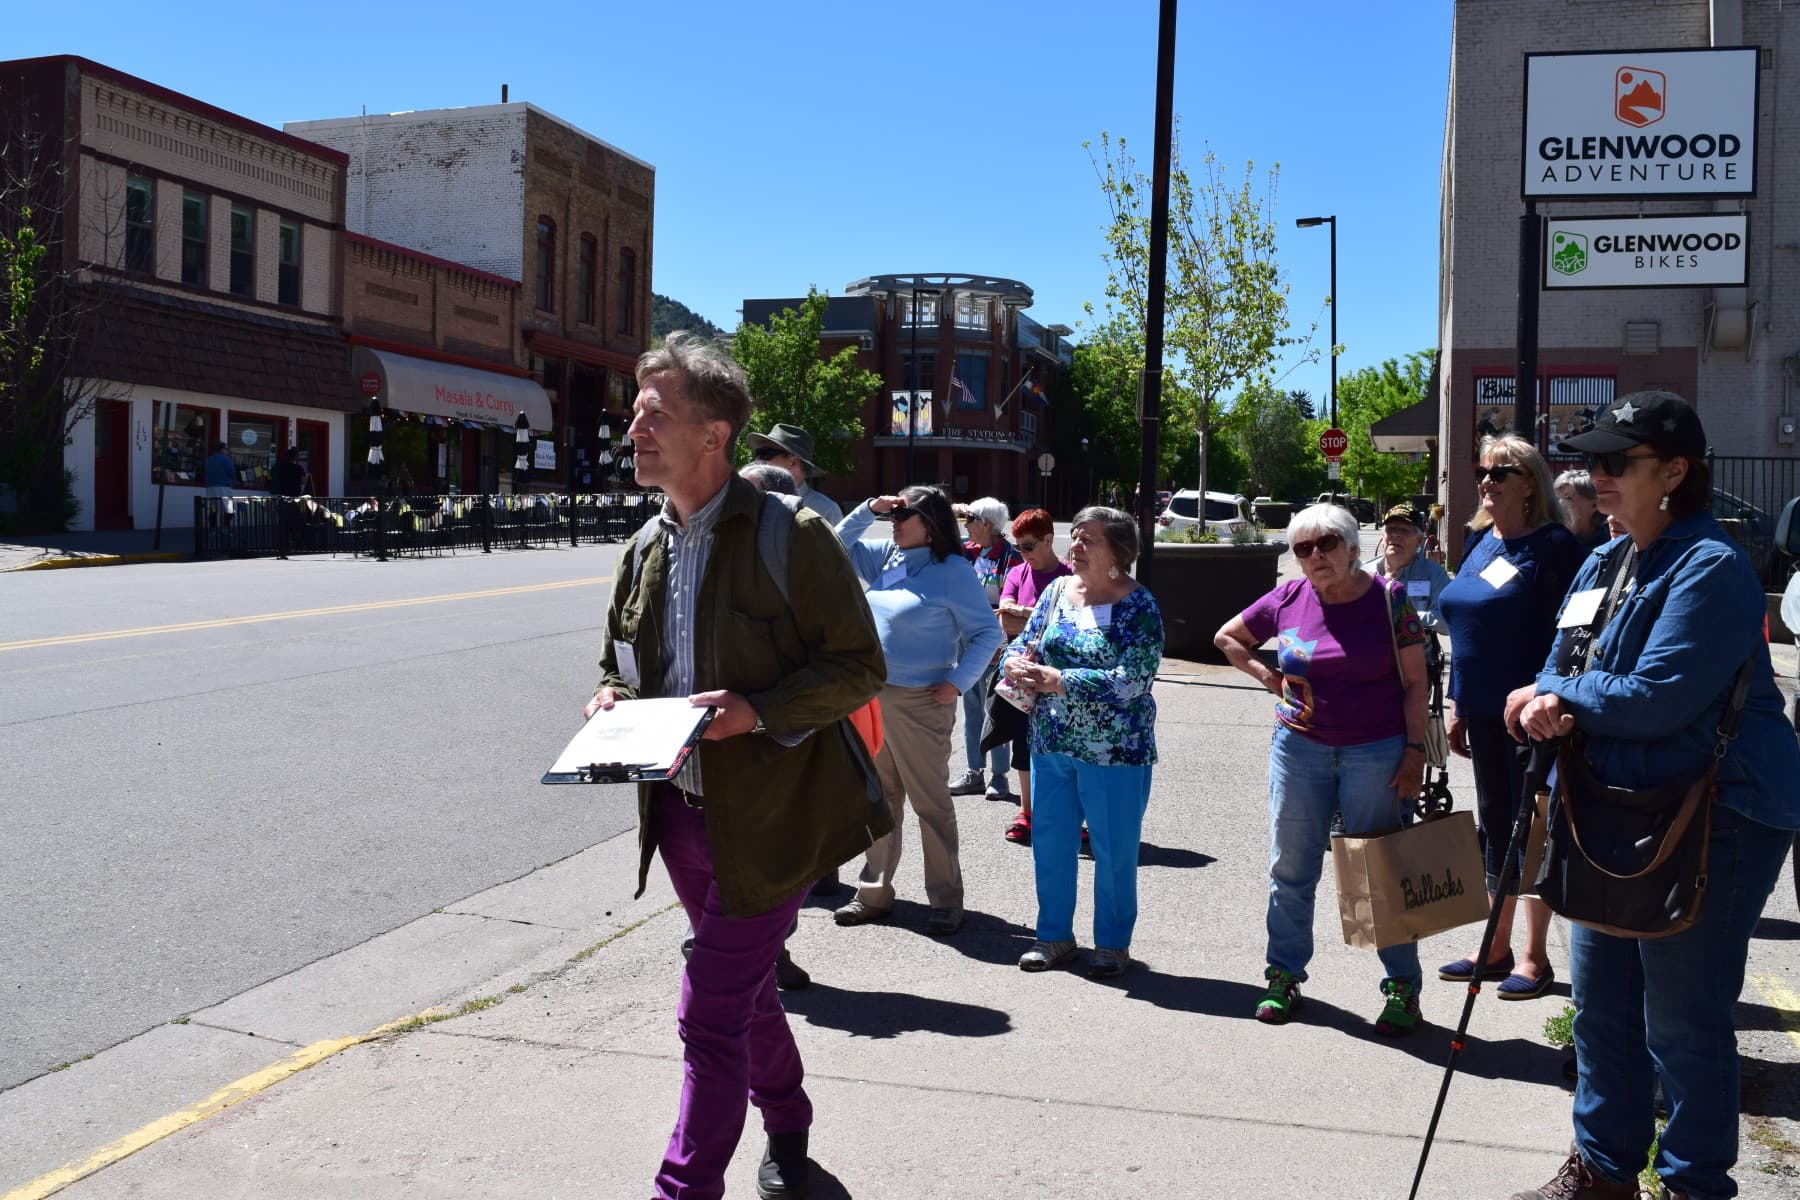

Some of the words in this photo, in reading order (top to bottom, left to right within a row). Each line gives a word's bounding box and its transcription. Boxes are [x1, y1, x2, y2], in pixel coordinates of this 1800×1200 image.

[1539, 134, 1741, 161] GLENWOOD
[1541, 163, 1737, 183] ADVENTURE
[1594, 233, 1741, 253] GLENWOOD
[1635, 255, 1698, 269] BIKES
[435, 385, 473, 406] Masala
[475, 391, 484, 409] &
[486, 393, 514, 416] Curry
[943, 427, 961, 437] FIRE
[967, 429, 1005, 439] STATION
[1321, 437, 1346, 449] STOP
[1401, 868, 1465, 910] Bullocks
